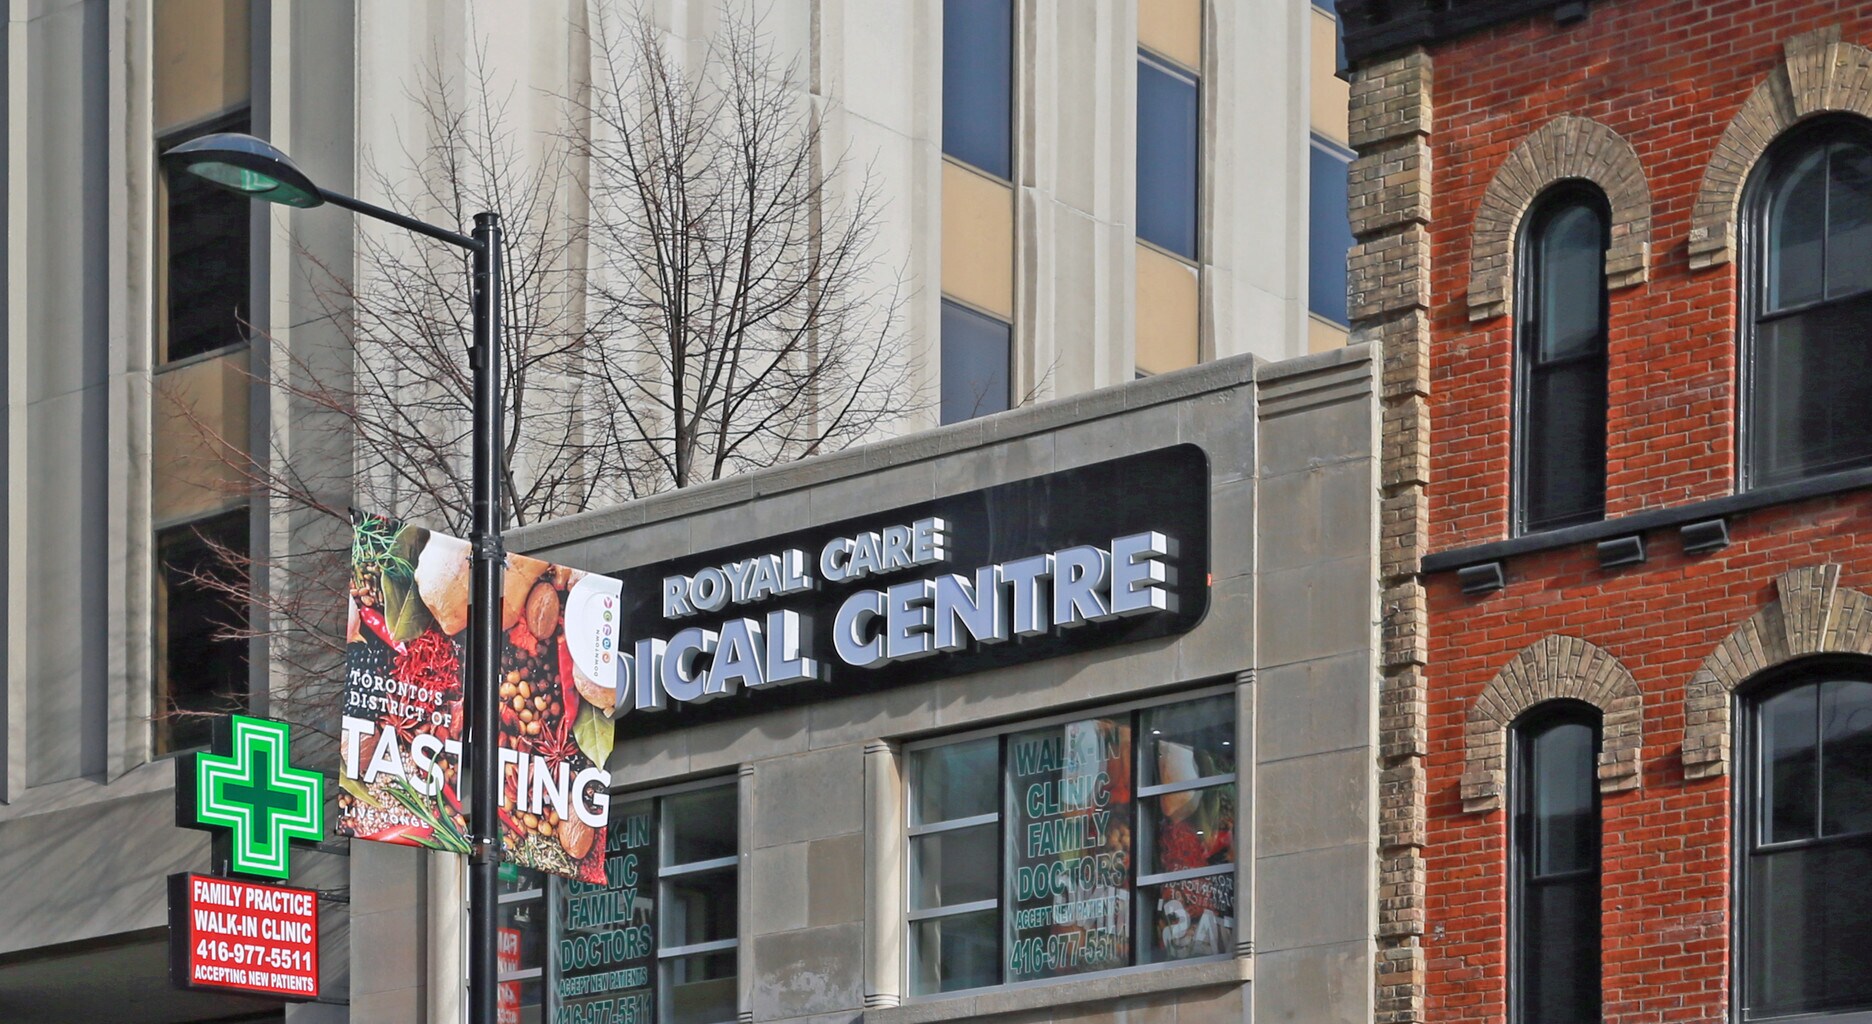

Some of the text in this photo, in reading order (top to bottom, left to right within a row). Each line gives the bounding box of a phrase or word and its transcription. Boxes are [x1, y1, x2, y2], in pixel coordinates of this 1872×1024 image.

[663, 517, 946, 619] ROYAL CARE
[833, 530, 1167, 668] CENTRE
[350, 670, 443, 706] TORONTO'S
[350, 691, 452, 727] DISTRICT OF
[1016, 726, 1121, 776] WALK-IN
[1027, 772, 1111, 819] CLINIC
[344, 805, 430, 830] LIVE YONGE
[1027, 810, 1111, 858] FAMILY
[1018, 850, 1127, 902] DOCTORS
[195, 881, 312, 916] FAMILY PRACTICE
[568, 888, 637, 931] FAMILY
[1016, 905, 1052, 930] ACCEPT
[1054, 902, 1075, 924] NEW
[194, 909, 312, 944] WALK-IN CLINIC
[196, 939, 312, 971] 416-977-5511
[561, 923, 653, 972] DOCTORS
[1010, 927, 1128, 975] 416-977-5511
[195, 965, 314, 992] ACCEPTING NEW PATIENTS
[559, 966, 648, 998] ACCEPT NEW PATIENTS
